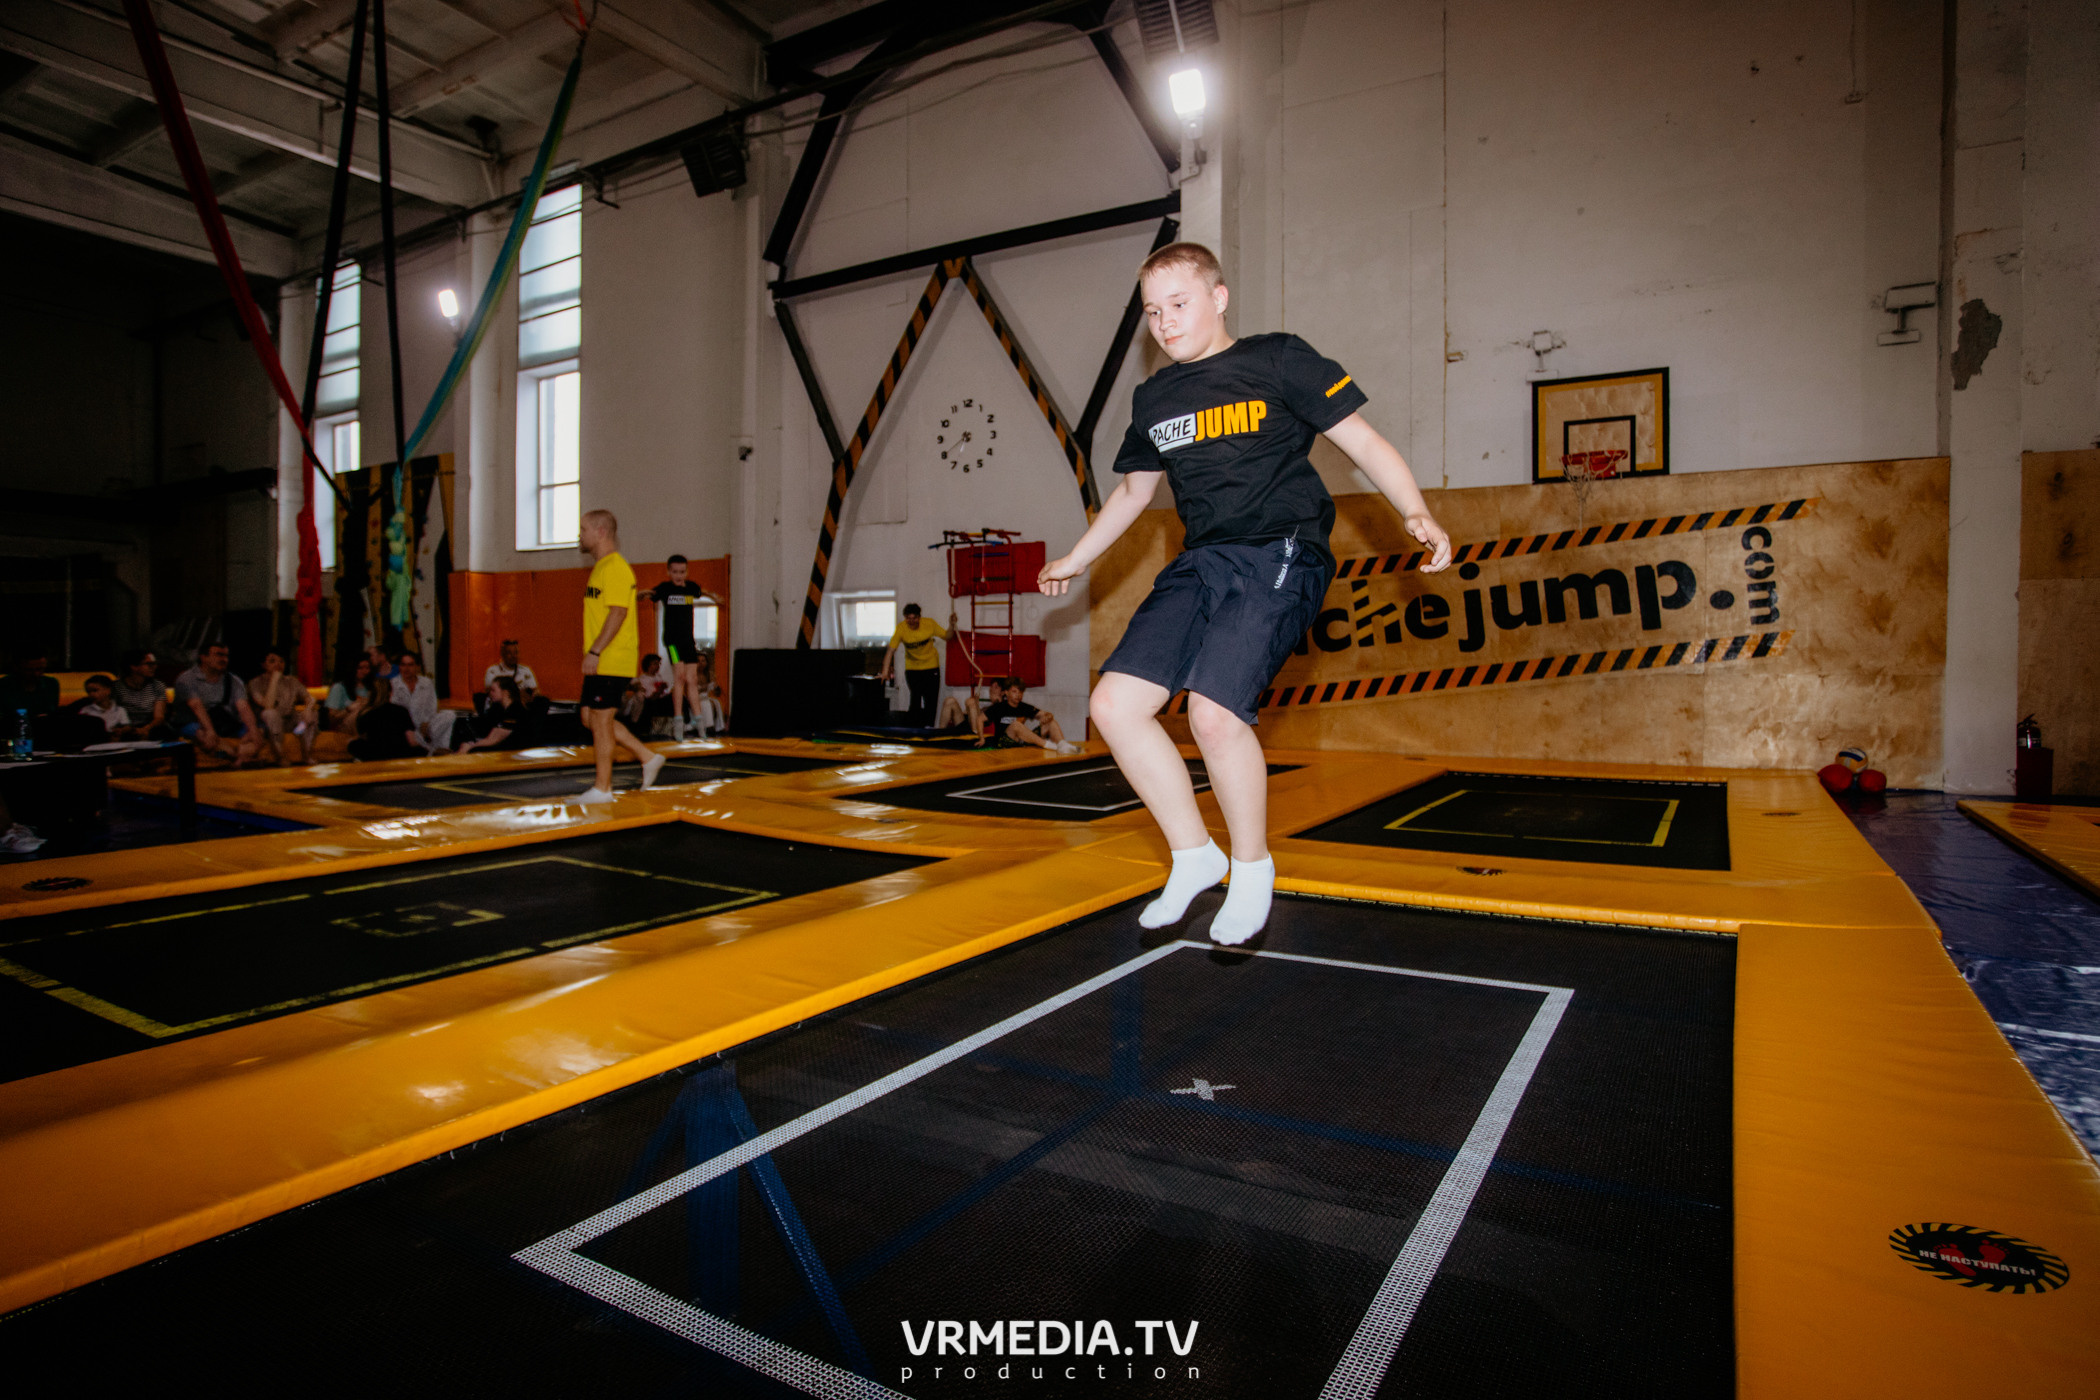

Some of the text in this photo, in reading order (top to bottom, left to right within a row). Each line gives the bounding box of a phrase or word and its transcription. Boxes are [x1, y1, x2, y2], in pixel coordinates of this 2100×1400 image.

[963, 399, 973, 408] 12
[979, 404, 983, 412] 1
[951, 405, 958, 414] 11
[987, 414, 994, 423] 2
[1195, 400, 1267, 442] JUMP
[941, 419, 950, 428] 10
[937, 434, 944, 444] 9
[990, 430, 997, 439] 3
[941, 451, 948, 460] 8
[986, 447, 993, 456] 4
[951, 461, 957, 470] 7
[977, 459, 983, 468] 5
[963, 464, 970, 473] 6
[1741, 526, 1780, 626] com
[1919, 1250, 2036, 1276] НЕ НАСТУПАТЬ!
